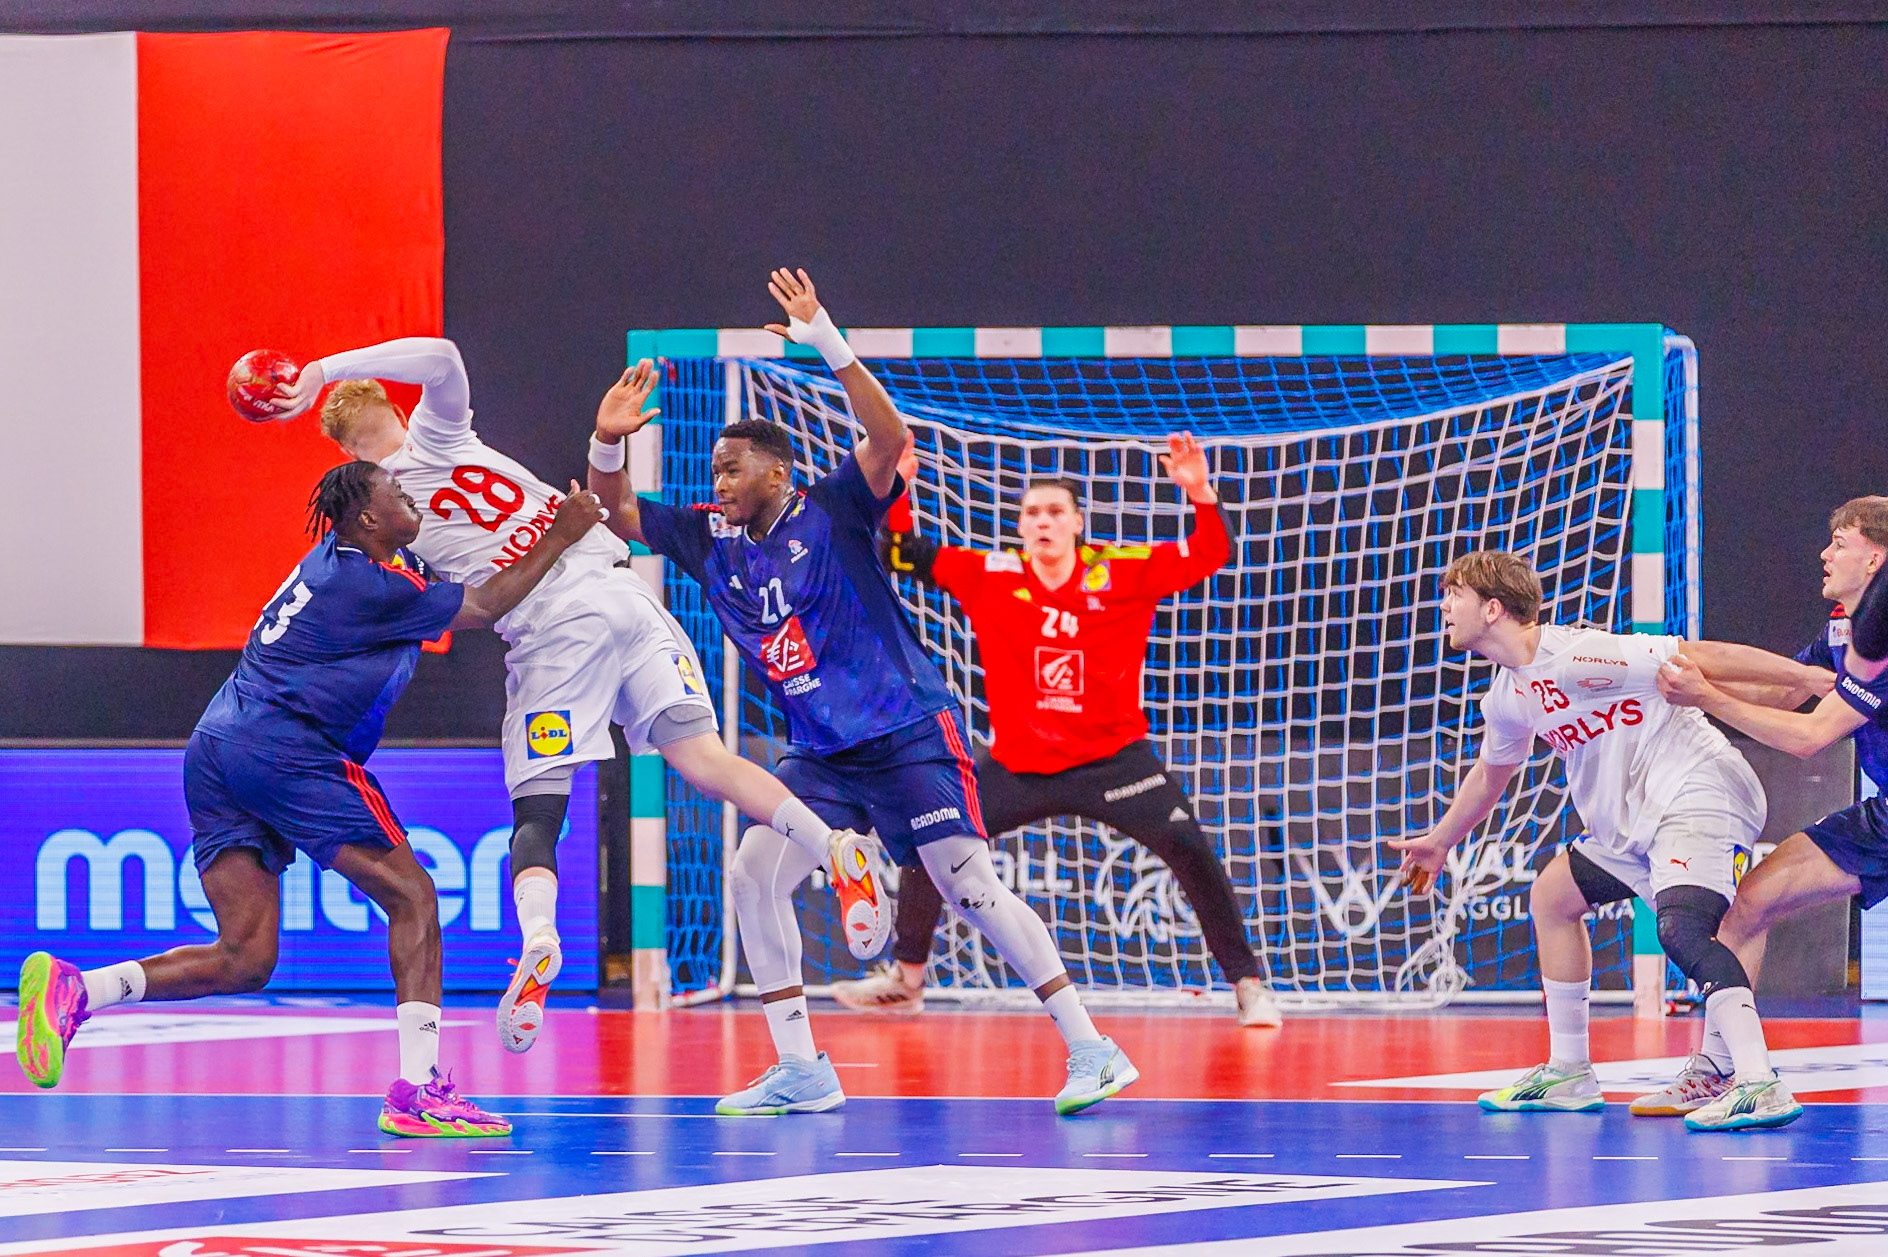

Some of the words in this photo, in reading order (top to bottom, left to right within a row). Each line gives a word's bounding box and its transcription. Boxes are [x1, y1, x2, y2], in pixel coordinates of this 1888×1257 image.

[430, 465, 525, 533] 28
[759, 577, 793, 625] 22
[1041, 606, 1079, 638] 24
[1572, 655, 1629, 667] NORLYS
[1530, 679, 1570, 714] 25
